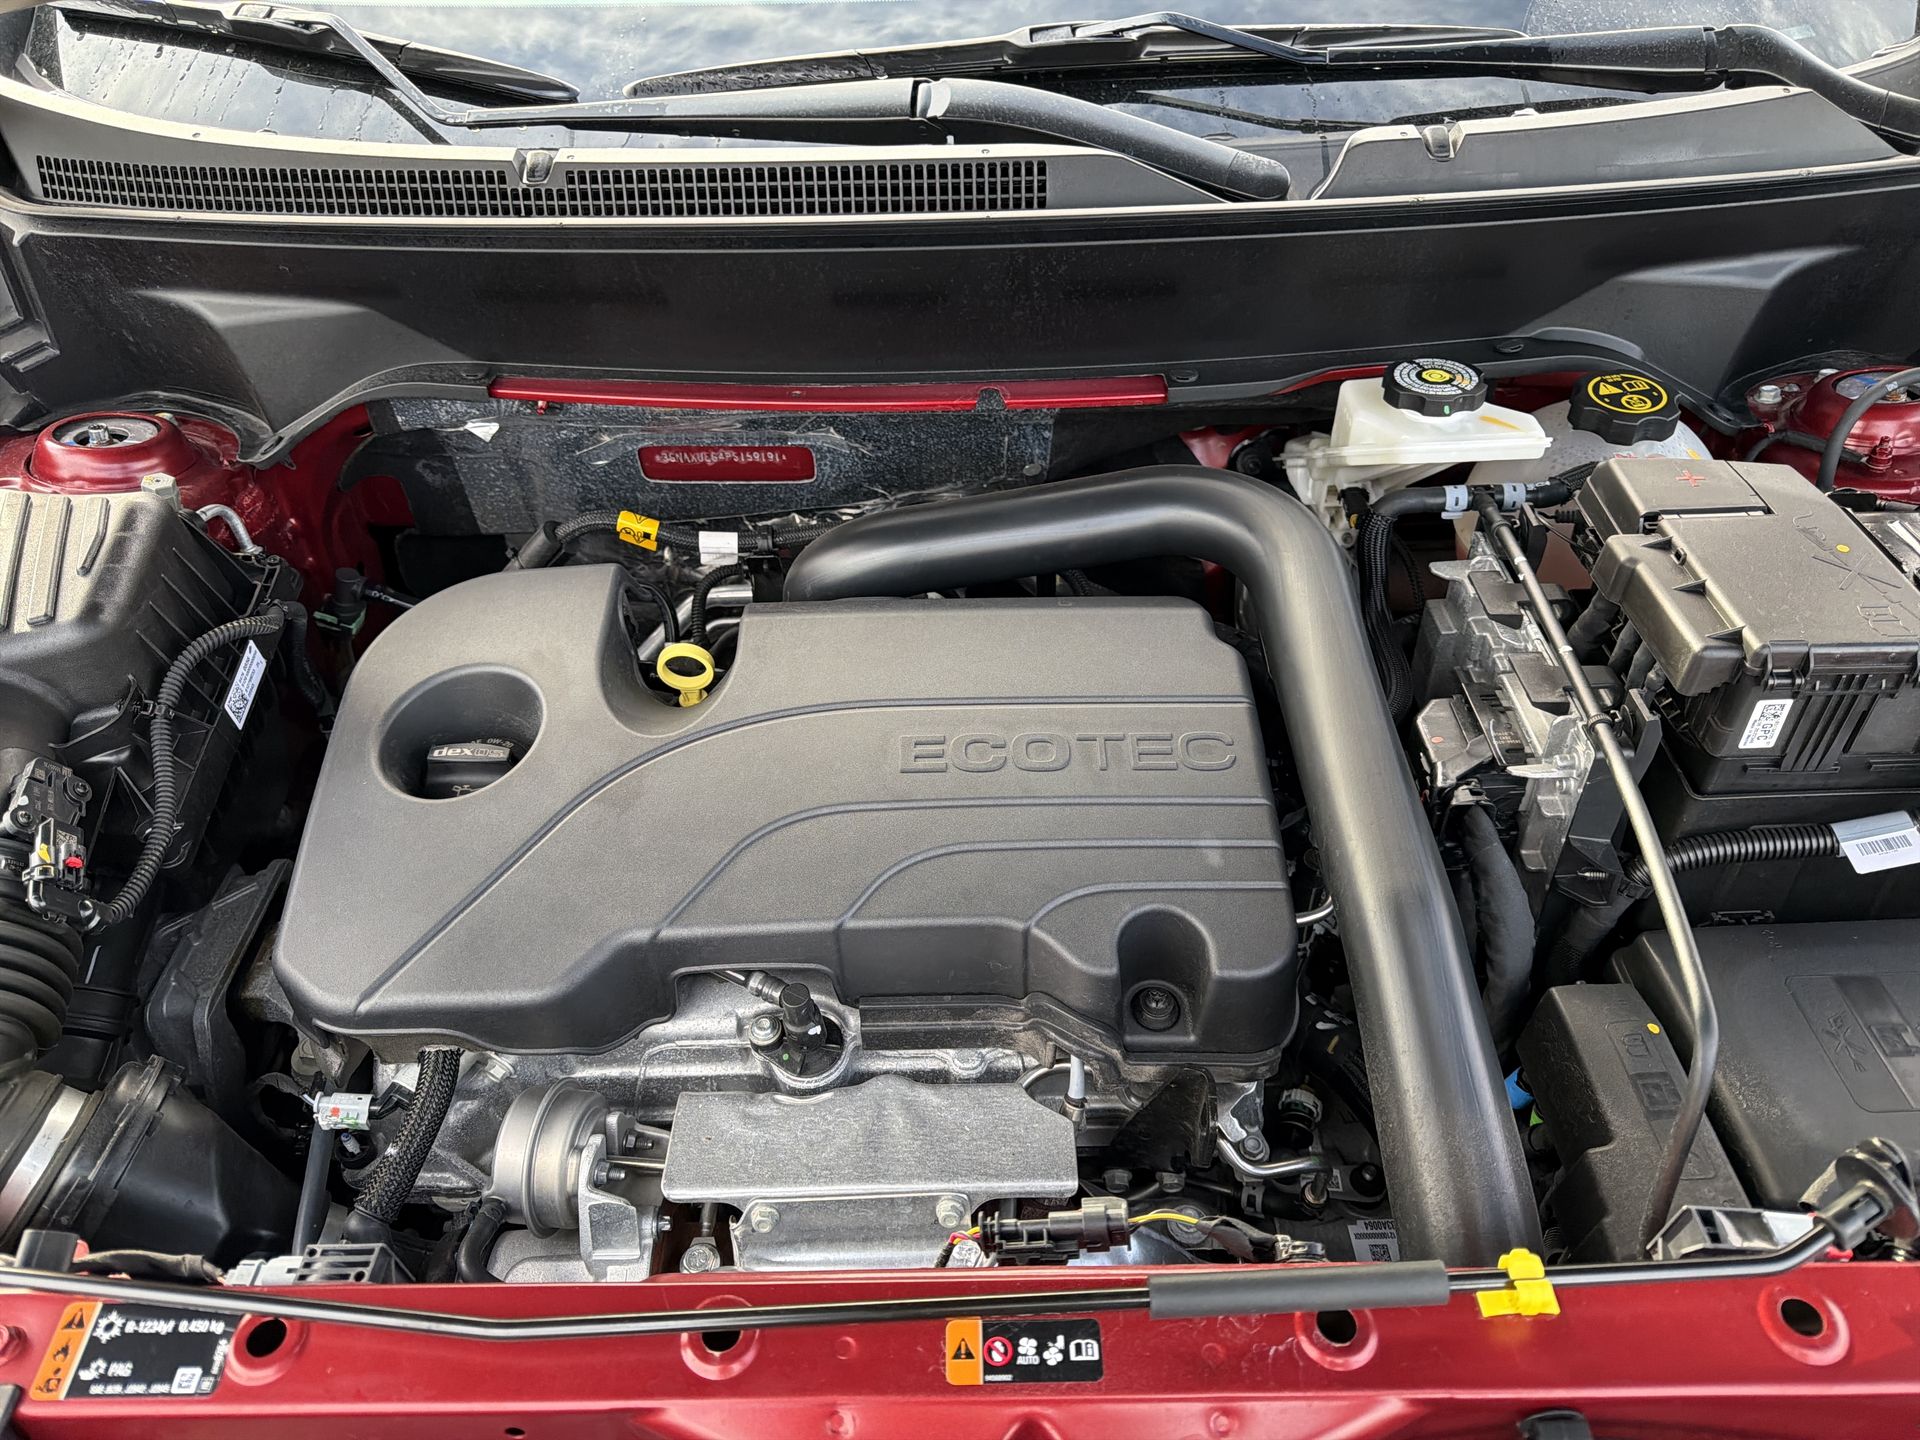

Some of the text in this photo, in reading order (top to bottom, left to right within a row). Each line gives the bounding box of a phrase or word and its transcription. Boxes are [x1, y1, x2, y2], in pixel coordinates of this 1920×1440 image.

[1756, 723, 1773, 741] GPC
[432, 746, 505, 758] dexos
[899, 731, 1237, 773] ECOTEC
[1016, 1355, 1040, 1365] AUTO
